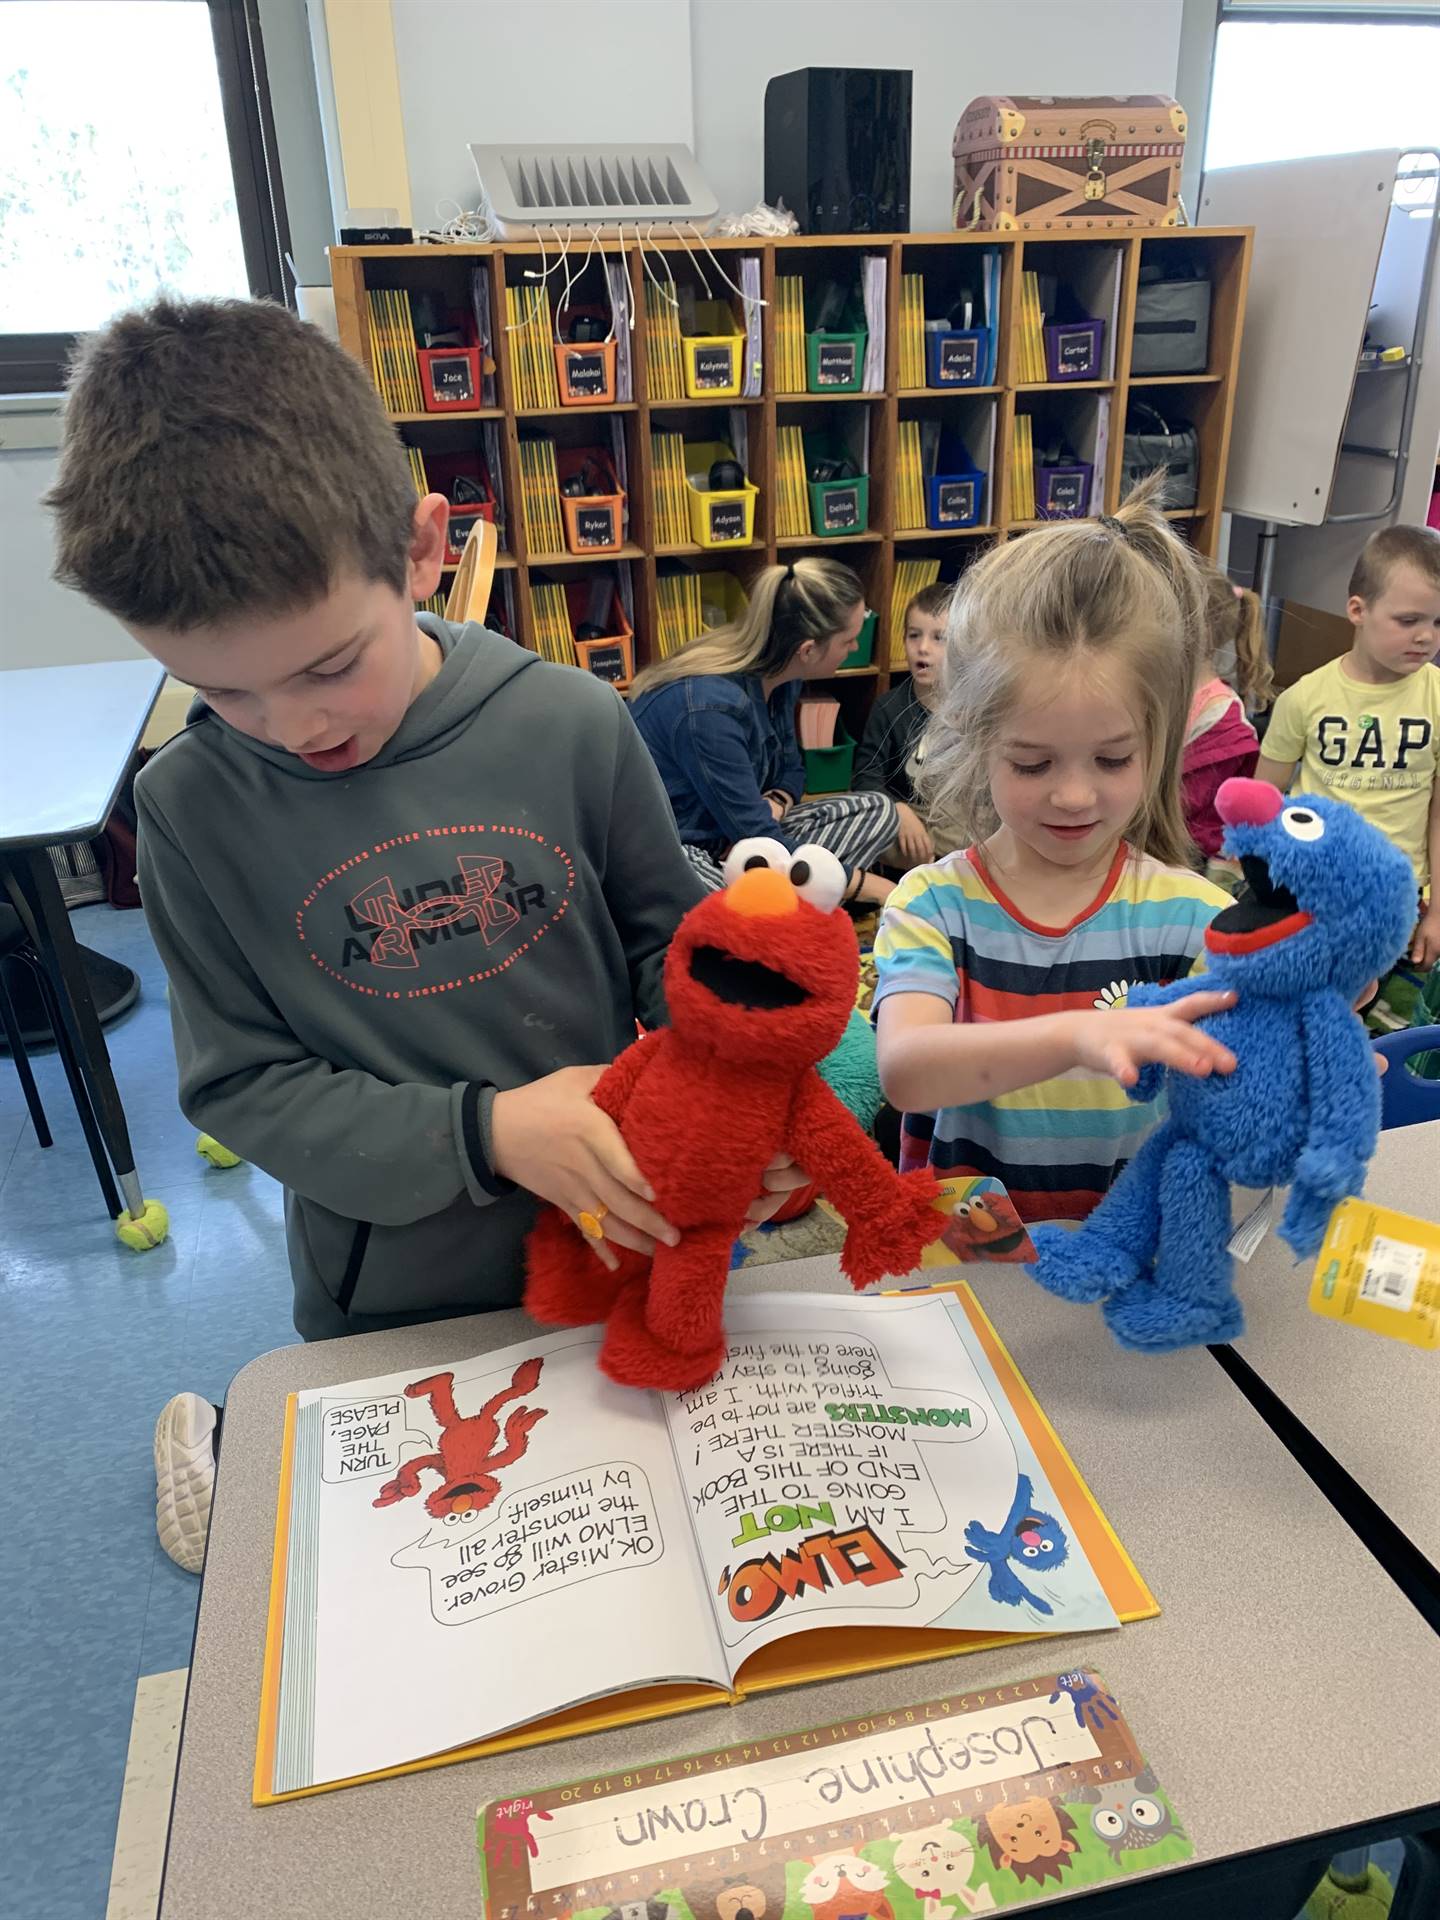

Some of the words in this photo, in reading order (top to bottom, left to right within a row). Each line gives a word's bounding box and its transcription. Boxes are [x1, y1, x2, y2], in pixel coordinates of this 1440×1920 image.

[1063, 345, 1088, 356] Carter
[443, 372, 463, 383] Jace
[571, 366, 601, 378] Malakai
[584, 520, 608, 532] Ryker
[1318, 715, 1432, 769] GAP
[722, 1344, 766, 1364] first
[768, 1343, 802, 1362] the
[807, 1343, 829, 1357] on
[835, 1344, 877, 1362] here
[731, 1364, 776, 1380] stay
[813, 1356, 876, 1381] going
[723, 1386, 743, 1405] I
[748, 1381, 808, 1401] with.
[811, 1381, 883, 1401] trifled
[685, 1390, 718, 1415] am
[745, 1402, 780, 1421] not
[787, 1401, 816, 1415] are
[329, 1400, 401, 1426] PLEASE
[721, 1408, 745, 1423] to
[823, 1402, 972, 1429] MONSTERS
[330, 1420, 390, 1441] PAGE,
[689, 1414, 715, 1434] be
[792, 1422, 906, 1441] MONSTER
[342, 1438, 385, 1457] THE
[736, 1446, 756, 1463] A
[762, 1444, 784, 1460] IS
[790, 1442, 863, 1458] THERE
[867, 1444, 889, 1458] IF
[339, 1450, 391, 1475] TURN
[754, 1461, 812, 1481] THIS
[816, 1461, 848, 1477] OF
[857, 1461, 920, 1481] END
[603, 1469, 631, 1490] by
[692, 1468, 747, 1513] BOOK
[781, 1483, 818, 1500] TO
[826, 1481, 906, 1500] GOING
[507, 1478, 592, 1524] himself.
[599, 1493, 638, 1513] the
[720, 1486, 776, 1517] THE
[731, 1501, 837, 1549] NOT
[845, 1505, 885, 1526] AM
[893, 1507, 914, 1527] I
[487, 1503, 589, 1549] monster
[579, 1515, 648, 1544] ELMO
[459, 1538, 487, 1565] all
[532, 1531, 571, 1562] will
[493, 1545, 523, 1570] go
[440, 1566, 487, 1589] see
[718, 1524, 907, 1623] ELMO,
[443, 1571, 525, 1612] Grover.
[1032, 1682, 1040, 1692] 1
[1058, 1671, 1084, 1689] left
[977, 1695, 986, 1705] 4
[996, 1689, 1005, 1701] 3
[1012, 1686, 1023, 1696] 2
[926, 1707, 935, 1718] 7
[941, 1702, 950, 1713] 6
[960, 1698, 969, 1710] 5
[887, 1715, 896, 1726] 9
[905, 1710, 914, 1721] 8
[831, 1726, 849, 1739] 11
[857, 1720, 877, 1733] 10
[772, 1739, 791, 1753] 13
[800, 1733, 819, 1746] 12
[713, 1752, 732, 1765] 15
[742, 1745, 762, 1760] 14
[803, 1716, 1071, 1804] Josephine
[654, 1767, 673, 1780] 17
[683, 1760, 702, 1773] 16
[592, 1780, 612, 1794] 19
[623, 1774, 642, 1788] 18
[560, 1787, 582, 1801] 20
[495, 1799, 535, 1820] right
